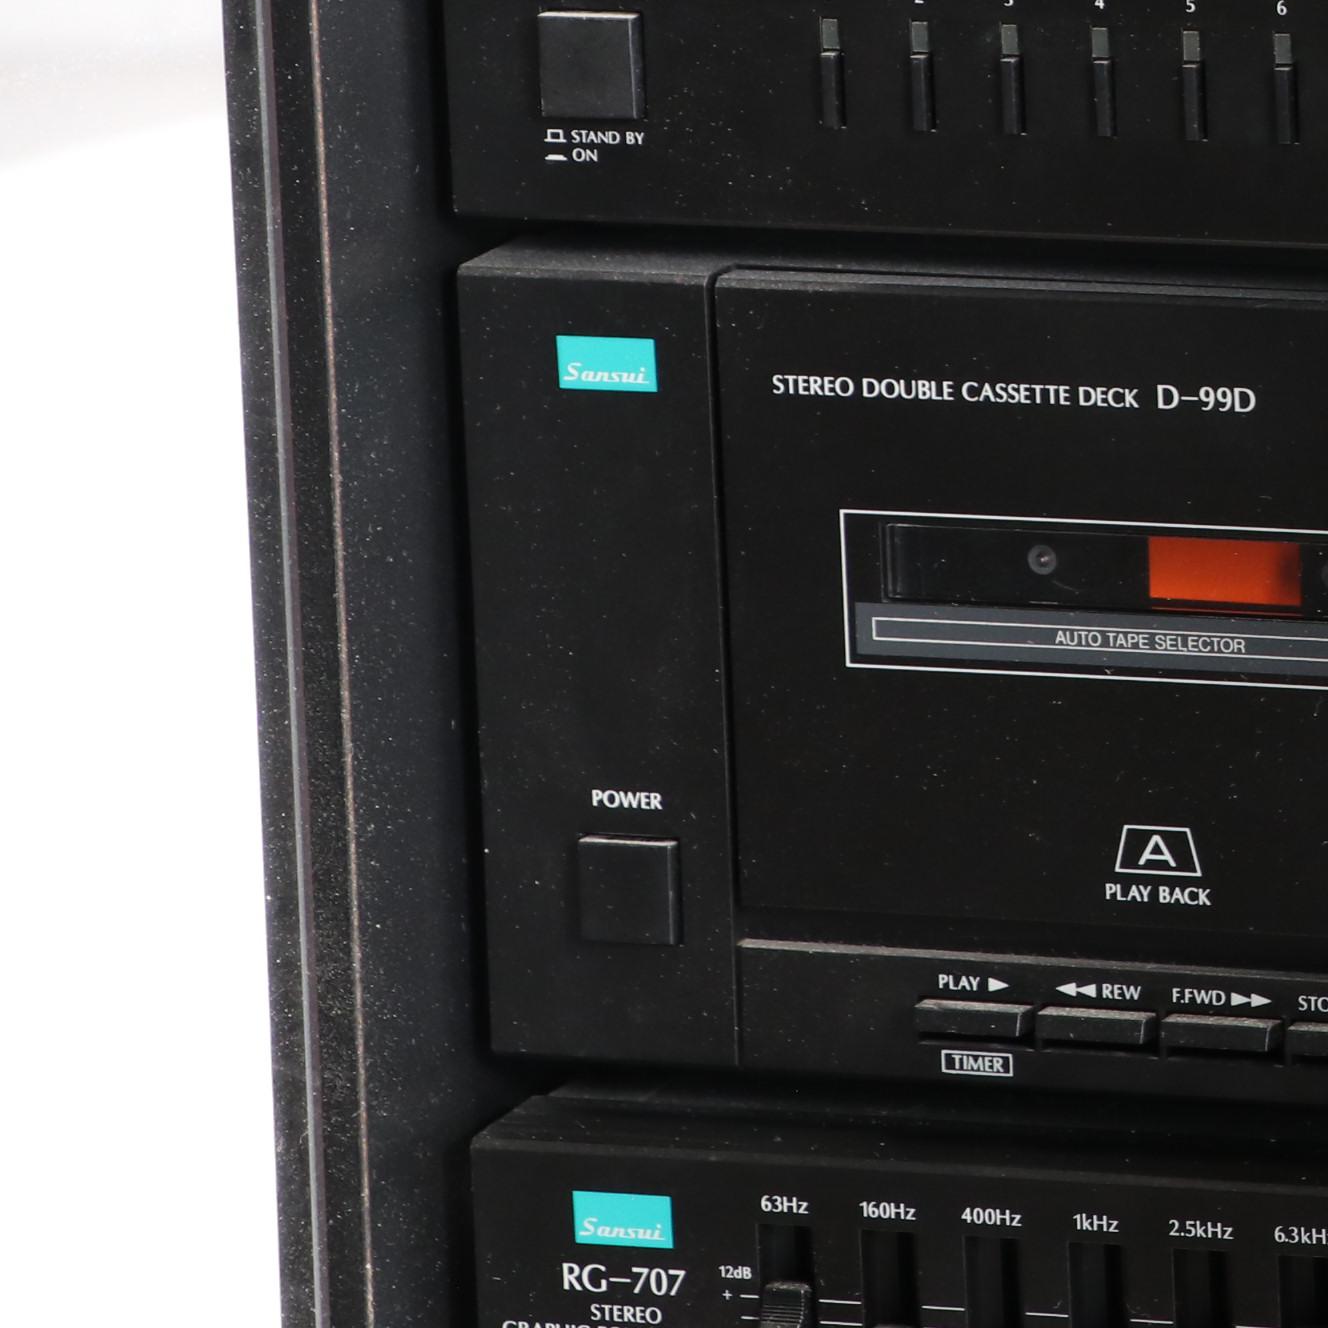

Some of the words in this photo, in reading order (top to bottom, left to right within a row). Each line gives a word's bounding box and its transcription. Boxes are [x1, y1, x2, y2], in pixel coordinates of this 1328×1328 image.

[1276, 0, 1288, 16] 6
[570, 129, 621, 145] STAND
[625, 131, 645, 145] BY
[572, 147, 598, 162] ON
[564, 362, 650, 385] Sansui
[772, 374, 855, 397] STEREO
[862, 377, 955, 401] DOUBLE
[961, 381, 1071, 406] CASSETTE
[1078, 386, 1140, 409] DECK
[1156, 384, 1256, 413] D-99D
[1054, 629, 1103, 651] AUTO
[1105, 632, 1152, 654] TAPE
[1153, 634, 1248, 658] SELECTOR
[591, 789, 663, 810] POWER
[1137, 834, 1177, 868] A
[1105, 883, 1152, 903] PLAY
[1158, 885, 1211, 906] BACK
[938, 973, 981, 992] PLAY
[1101, 983, 1142, 1001] REW
[1172, 987, 1226, 1006] F.FWD
[951, 1054, 1005, 1073] TIMER
[760, 1194, 809, 1214] 63Hz
[859, 1201, 917, 1221] 160Hz
[961, 1207, 1022, 1227] 400Hz
[1072, 1212, 1119, 1233] 1kHz
[579, 1218, 666, 1240] Sansui
[1168, 1219, 1234, 1240] 2.5kHz
[562, 1262, 687, 1296] RG-707
[718, 1265, 753, 1280] 12dB
[590, 1303, 663, 1325] STEREO
